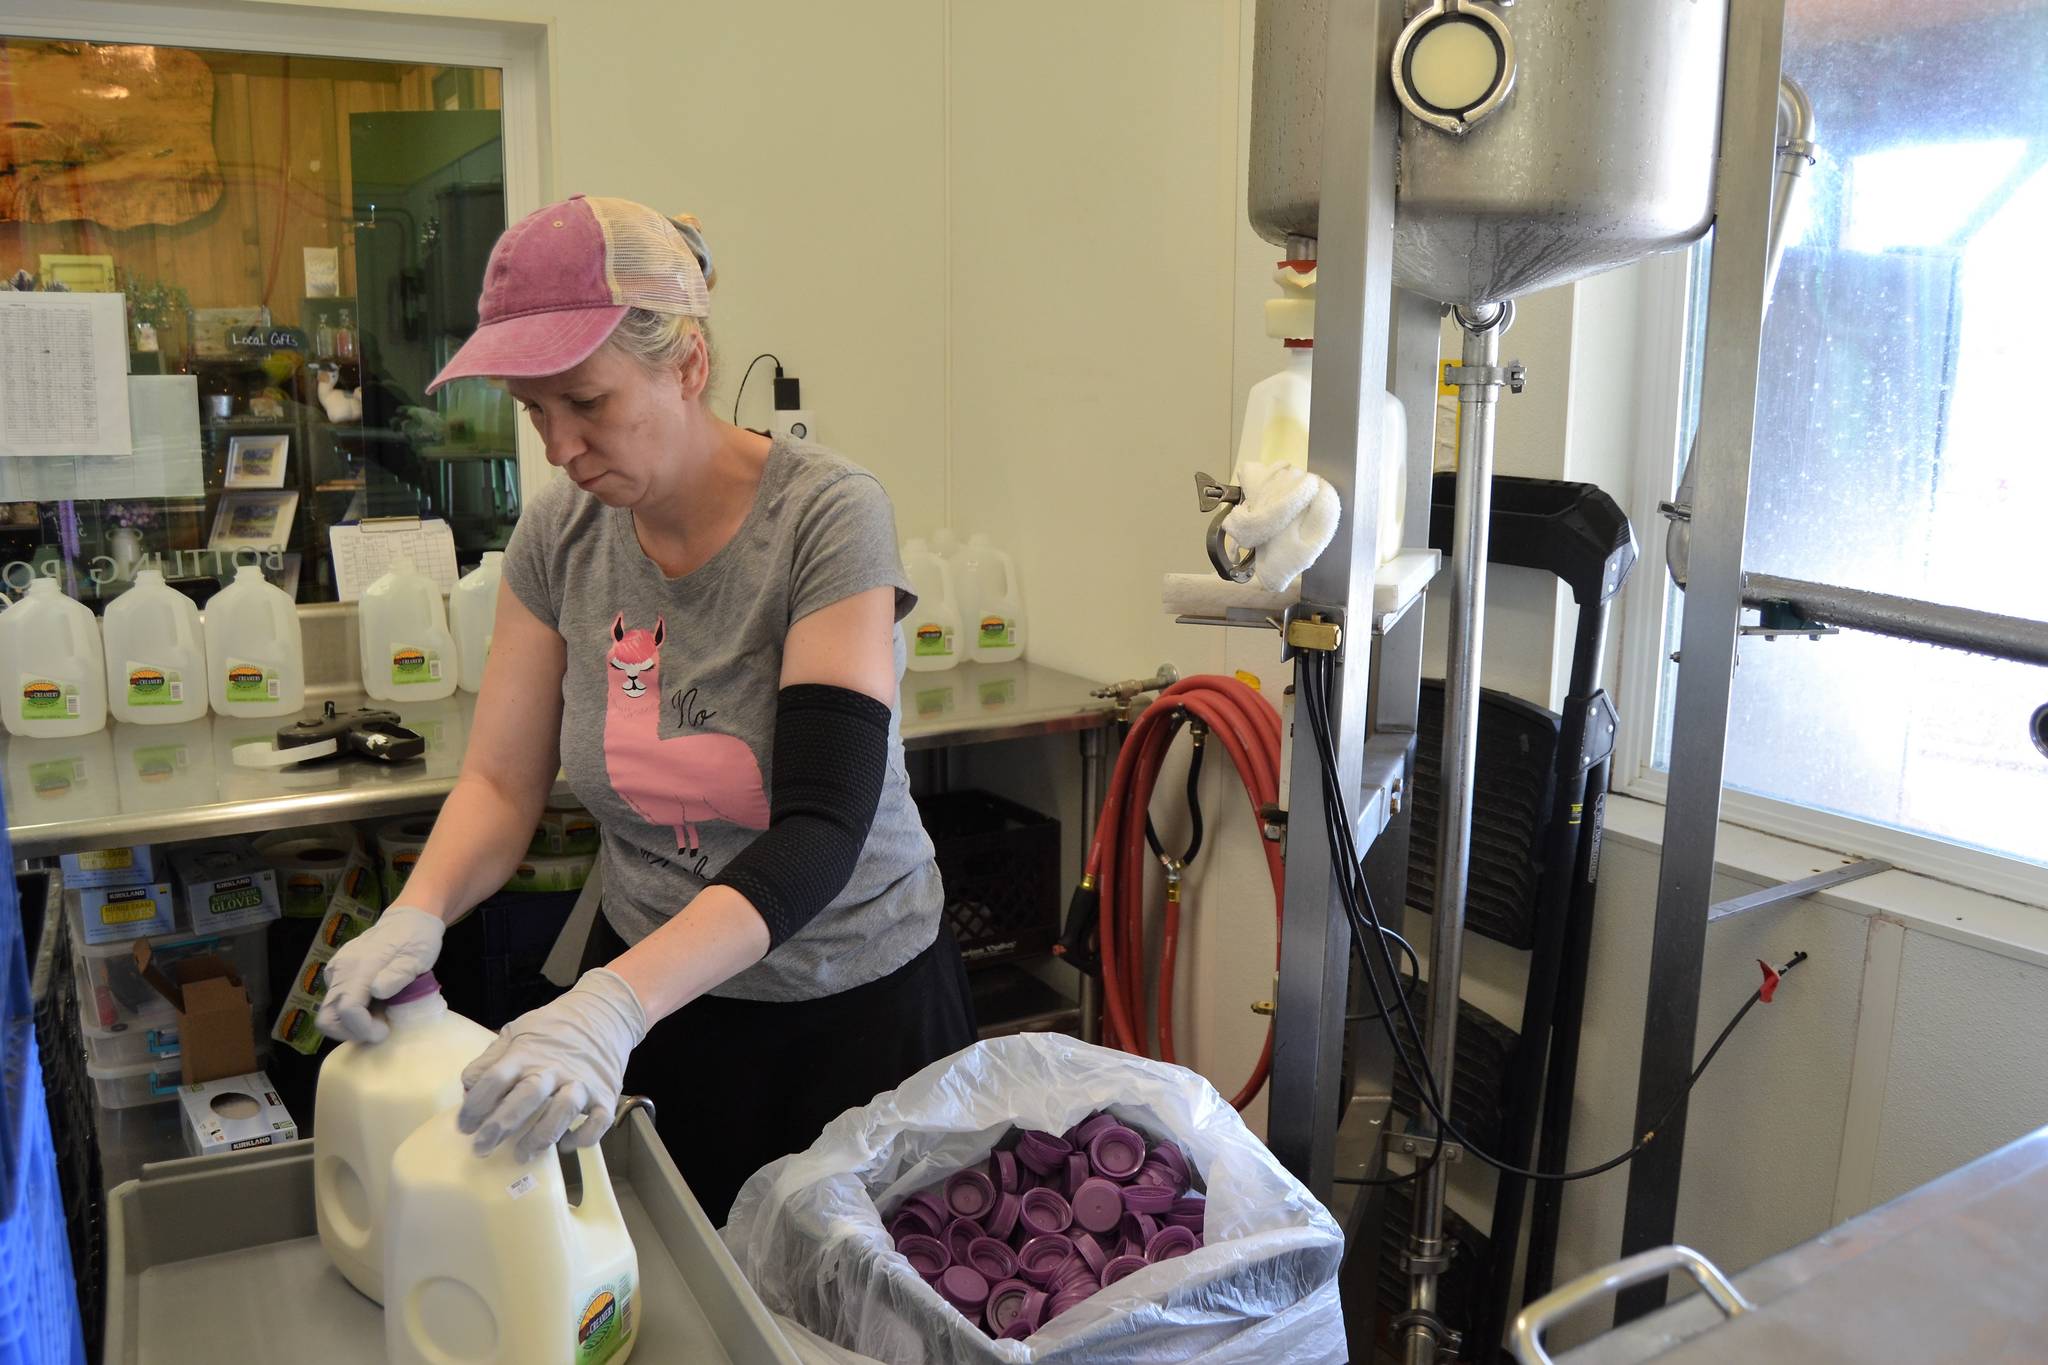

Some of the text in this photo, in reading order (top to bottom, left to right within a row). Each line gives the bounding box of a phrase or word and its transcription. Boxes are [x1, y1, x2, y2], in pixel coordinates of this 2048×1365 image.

[671, 687, 717, 729] No
[108, 889, 146, 900] KIRKLAND
[211, 895, 261, 913] GLOVES
[232, 1136, 271, 1150] KIRKLAND
